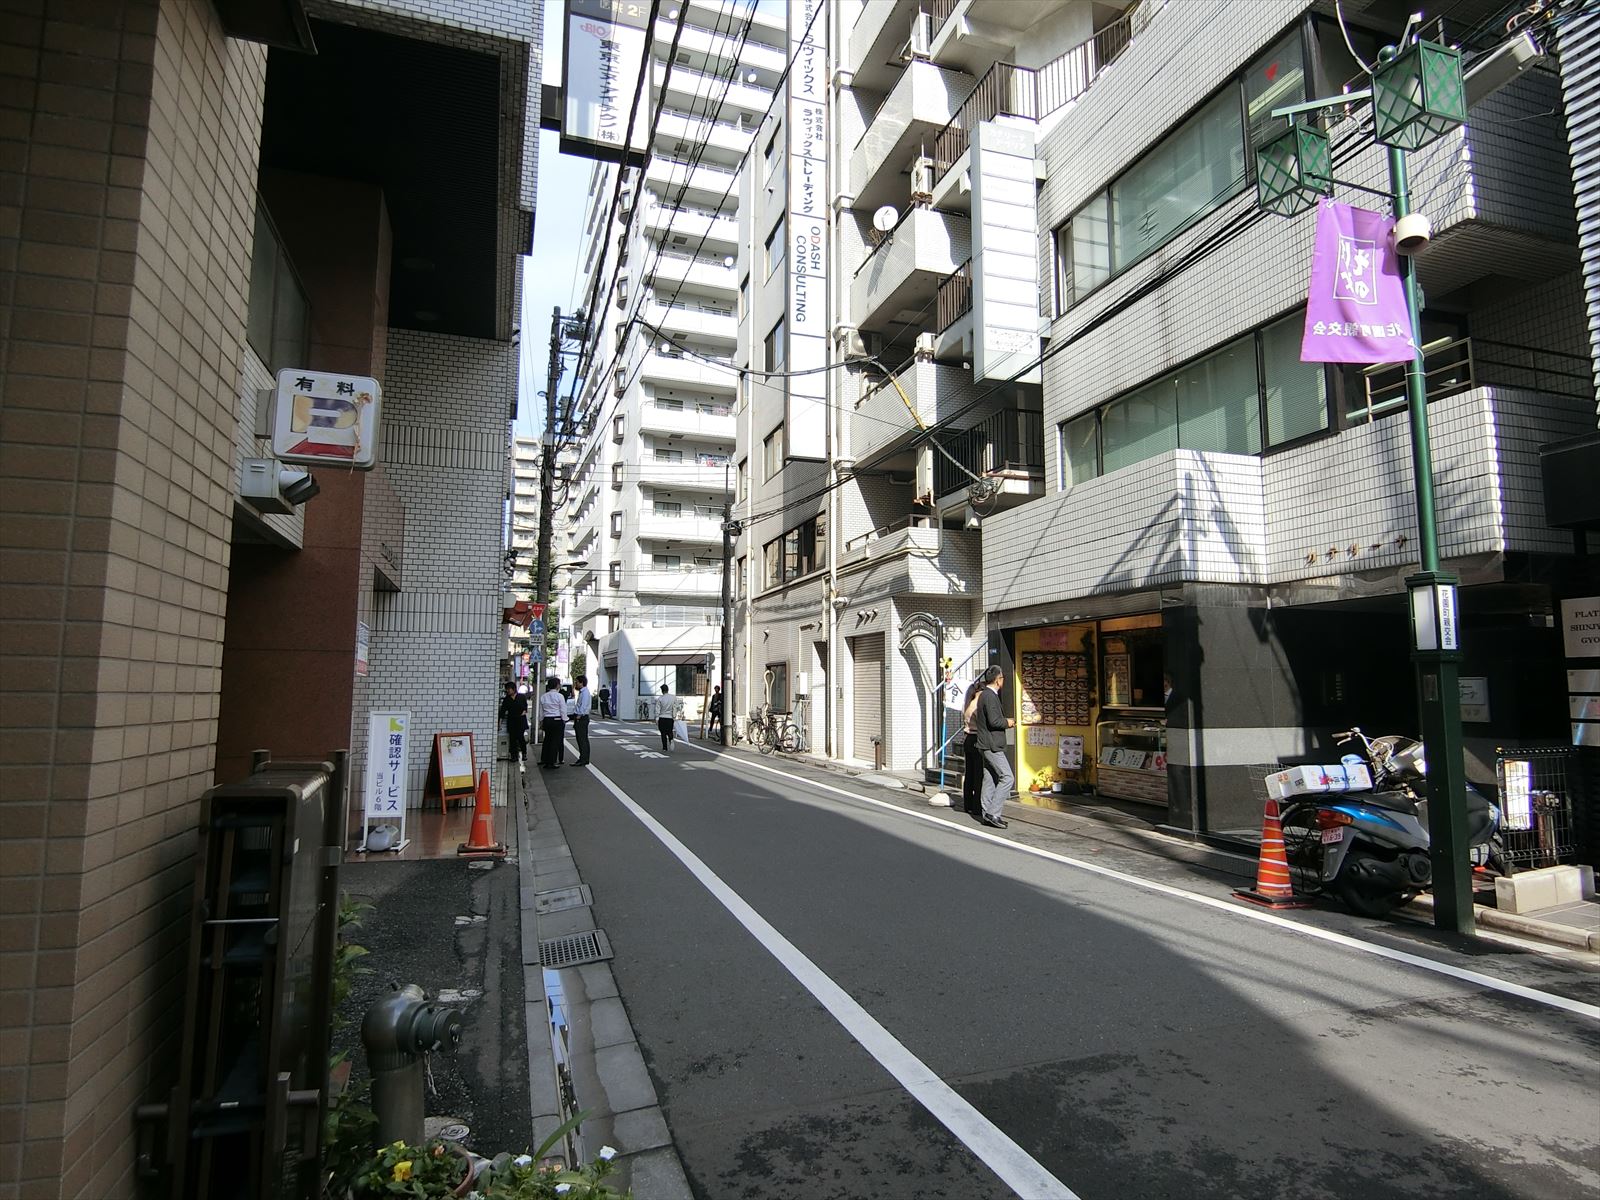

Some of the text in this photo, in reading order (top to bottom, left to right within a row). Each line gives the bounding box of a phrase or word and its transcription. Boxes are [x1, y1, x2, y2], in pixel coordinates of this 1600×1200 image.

[627, 4, 648, 17] 2F
[802, 0, 815, 95] 式会社ラヴィックス
[815, 107, 824, 141] 株式会社
[802, 108, 814, 214] ラヴィックストレーディング
[811, 226, 821, 271] ODASH
[795, 235, 807, 323] CONSULTING
[294, 376, 356, 397] 有料
[1575, 610, 1600, 618] PLAT
[374, 772, 384, 811] 当ビル6階
[386, 734, 402, 811] 確認サービス
